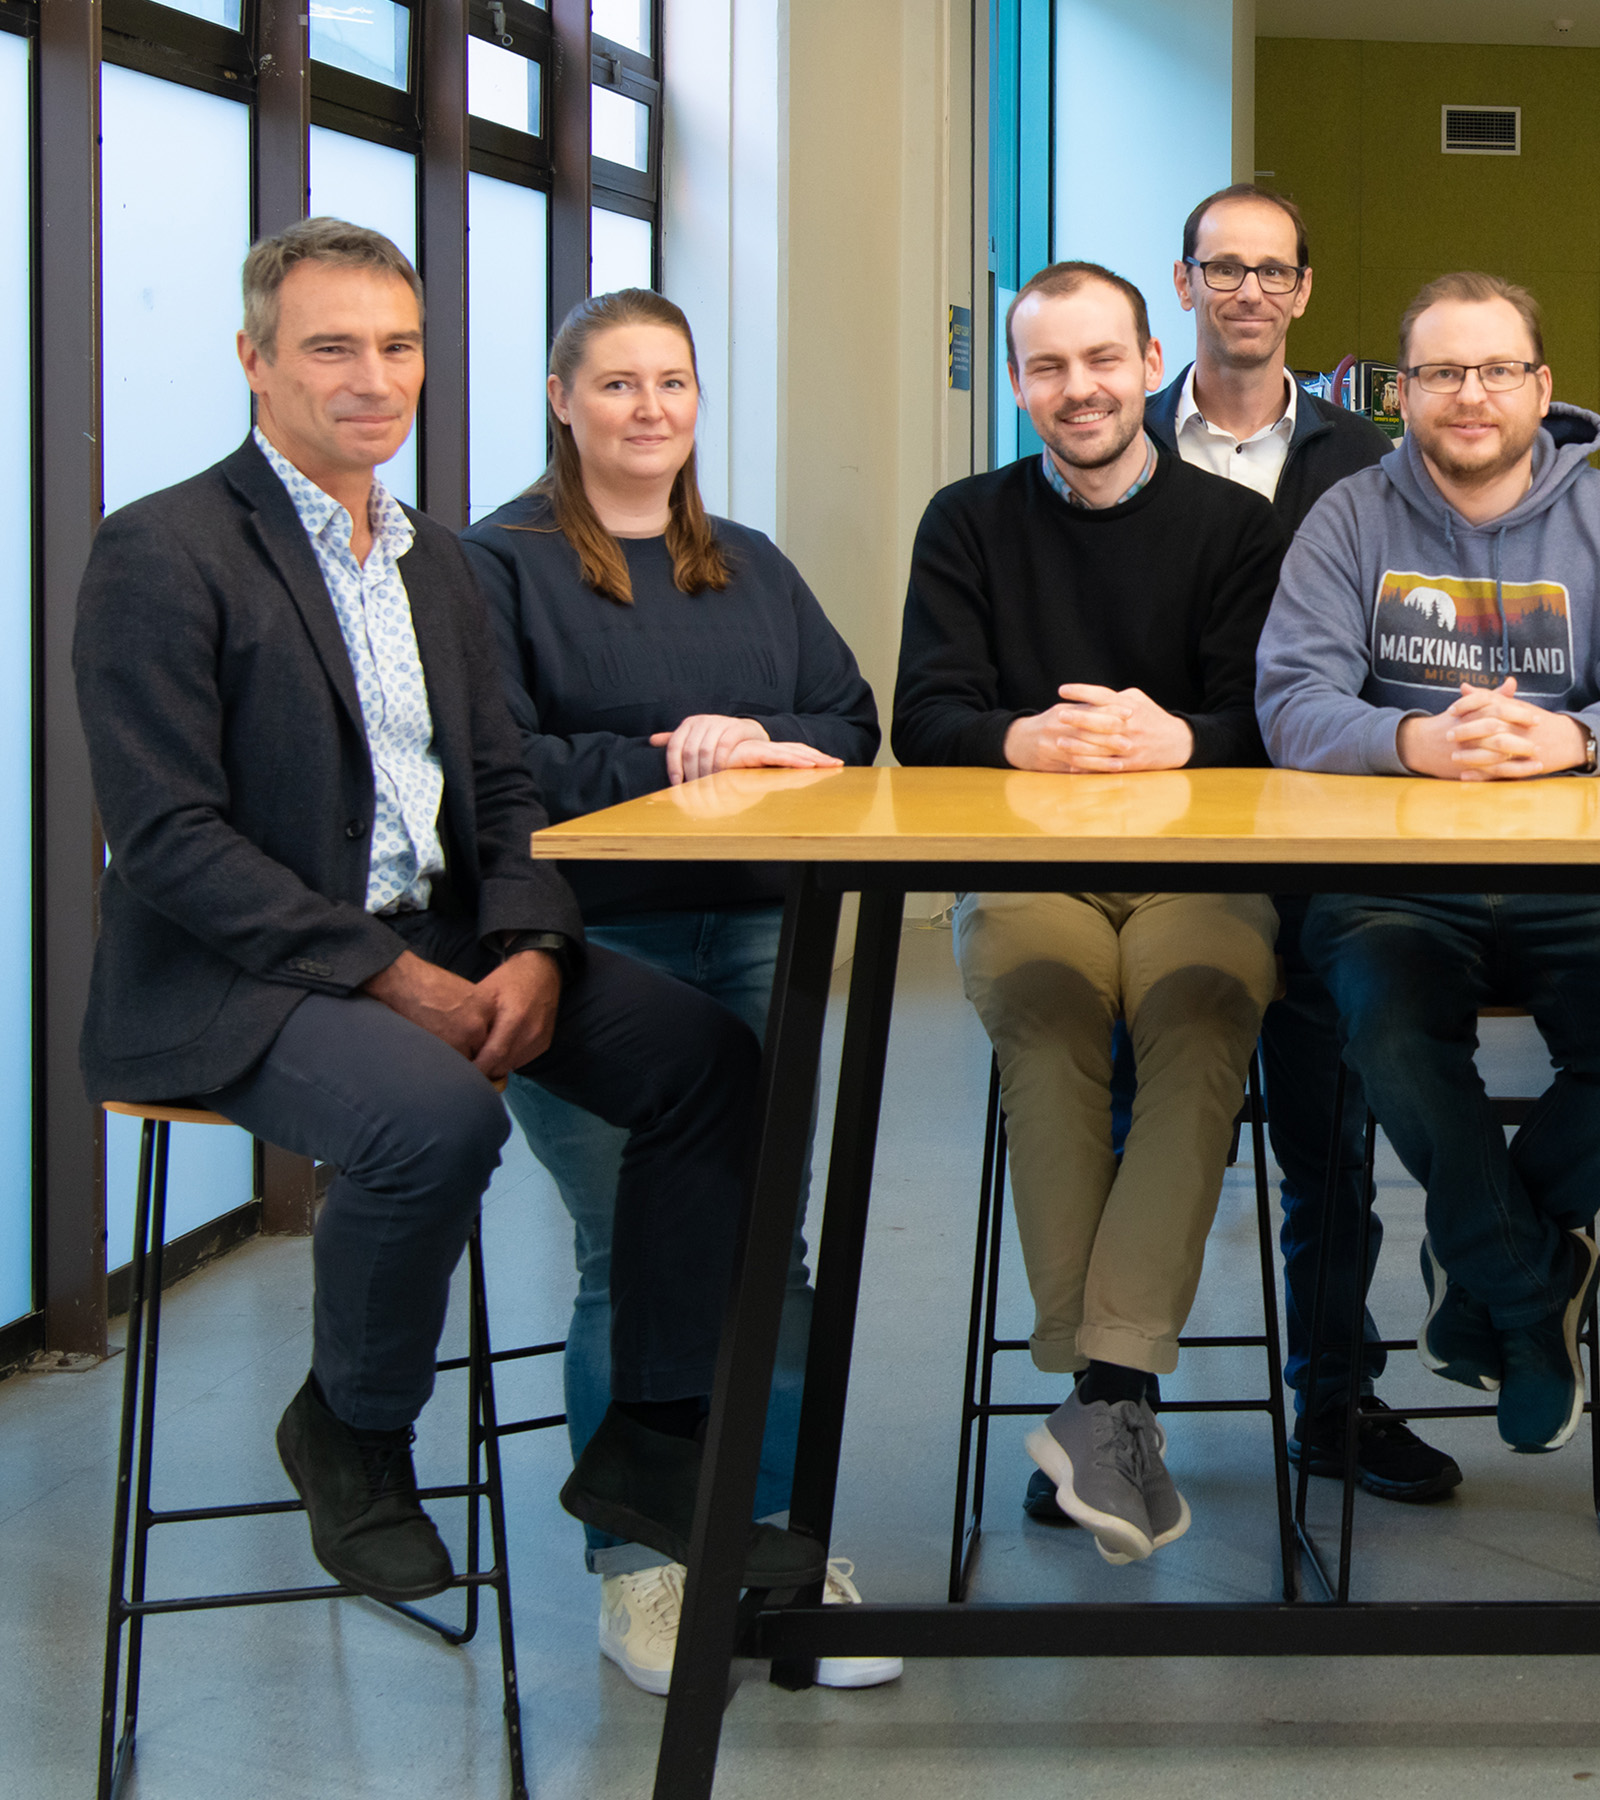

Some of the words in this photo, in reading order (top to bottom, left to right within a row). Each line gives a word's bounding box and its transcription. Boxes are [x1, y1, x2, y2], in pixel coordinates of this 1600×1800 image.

[1380, 634, 1482, 671] MACKINAC
[1490, 646, 1565, 674] ISLAND
[1425, 668, 1501, 686] MICHIGA
